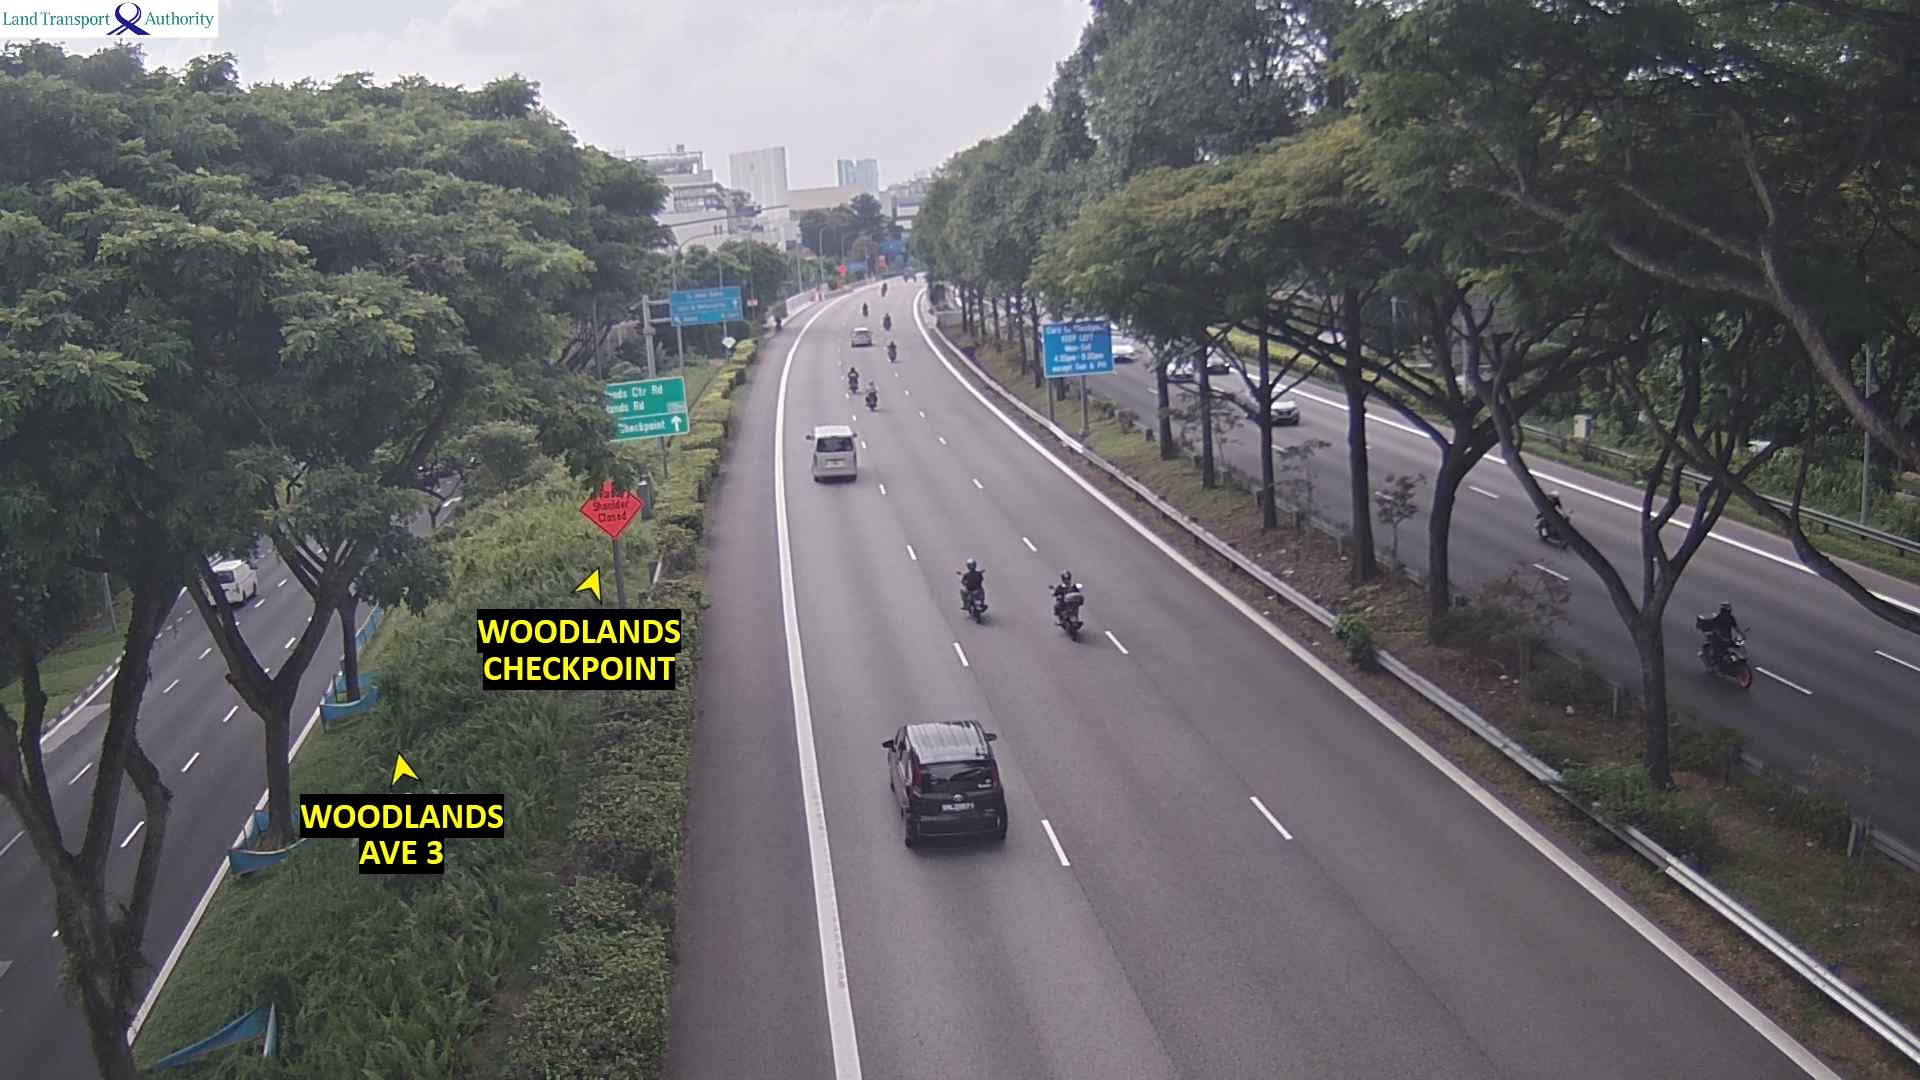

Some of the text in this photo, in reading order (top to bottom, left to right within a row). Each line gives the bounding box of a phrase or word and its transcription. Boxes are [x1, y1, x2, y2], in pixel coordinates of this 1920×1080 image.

[1060, 333, 1093, 343] KEEP LEFT
[632, 387, 646, 398] Ctr
[652, 384, 663, 395] Rd
[633, 400, 645, 411] Rd
[598, 511, 627, 523] Closed
